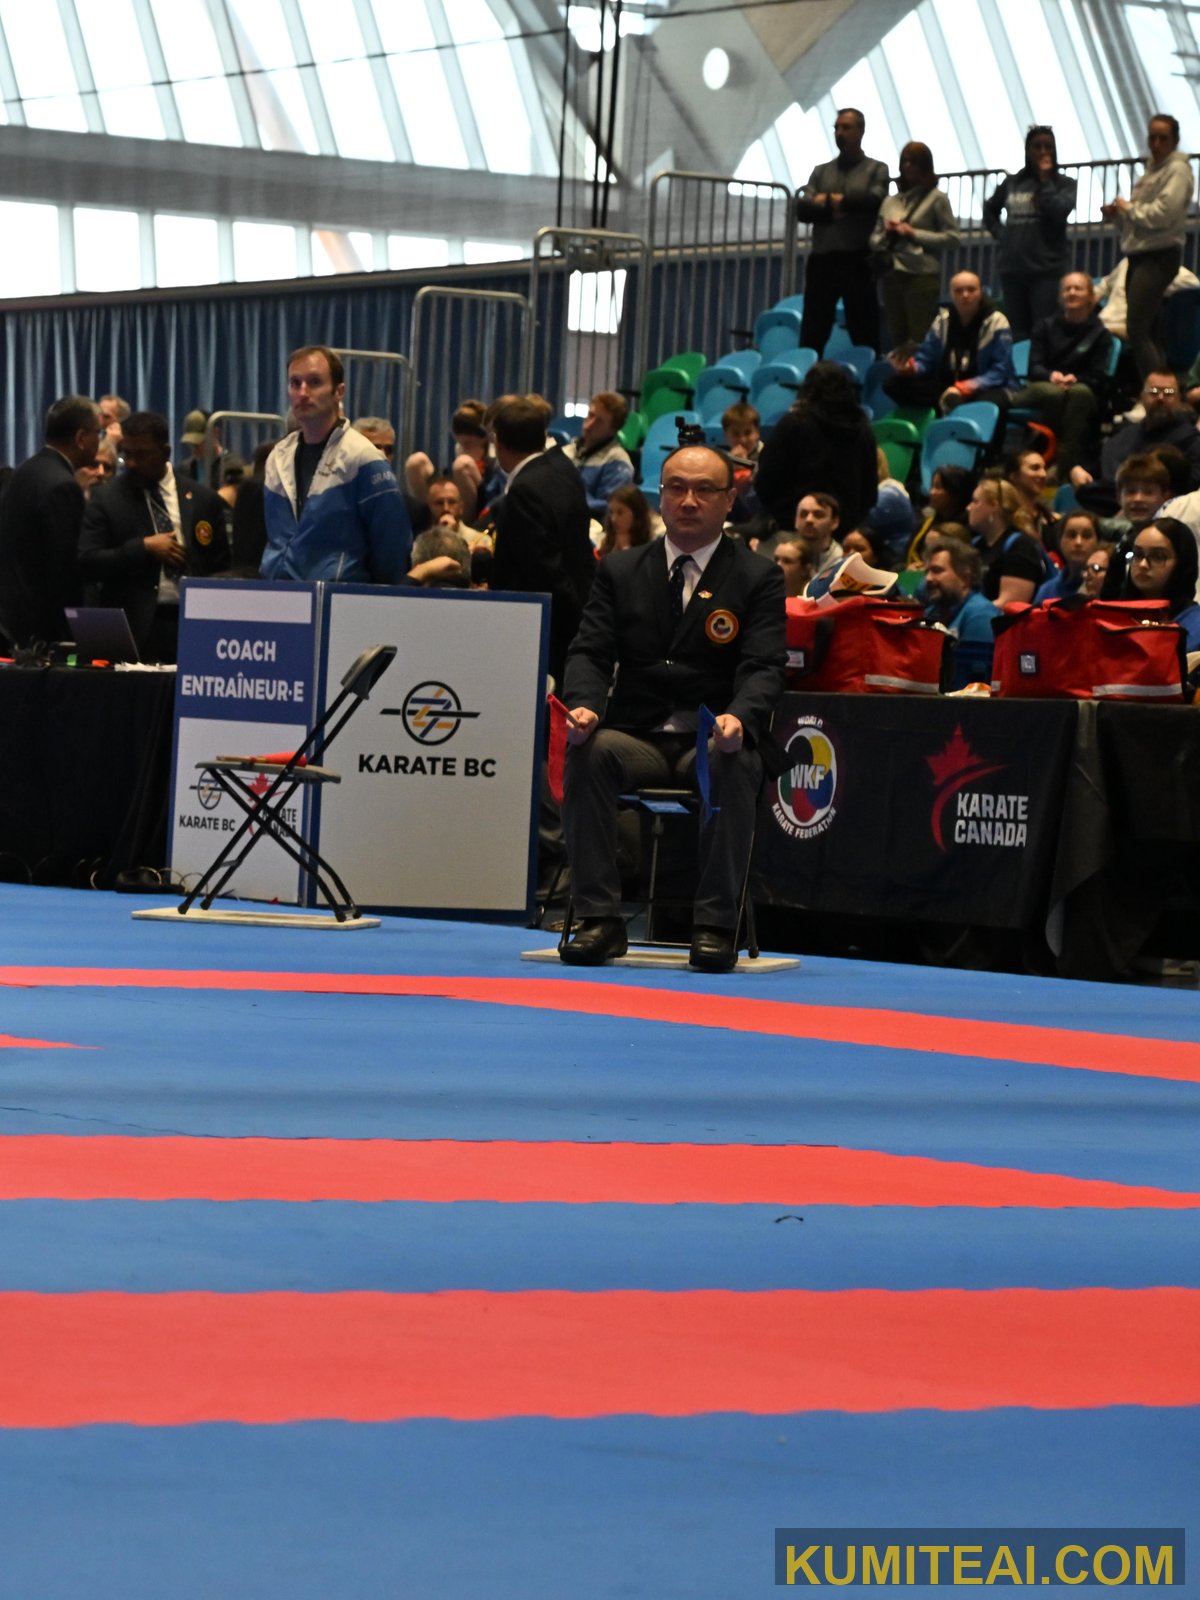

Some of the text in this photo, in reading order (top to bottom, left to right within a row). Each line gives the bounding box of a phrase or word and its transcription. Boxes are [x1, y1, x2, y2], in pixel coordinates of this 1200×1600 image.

[216, 638, 277, 662] COACH
[358, 754, 497, 778] KARATE BC
[790, 763, 826, 790] WKF
[772, 802, 796, 836] KARATE
[957, 792, 1029, 820] KARATE
[179, 814, 236, 832] KARATE BC
[954, 819, 1027, 848] CANADA
